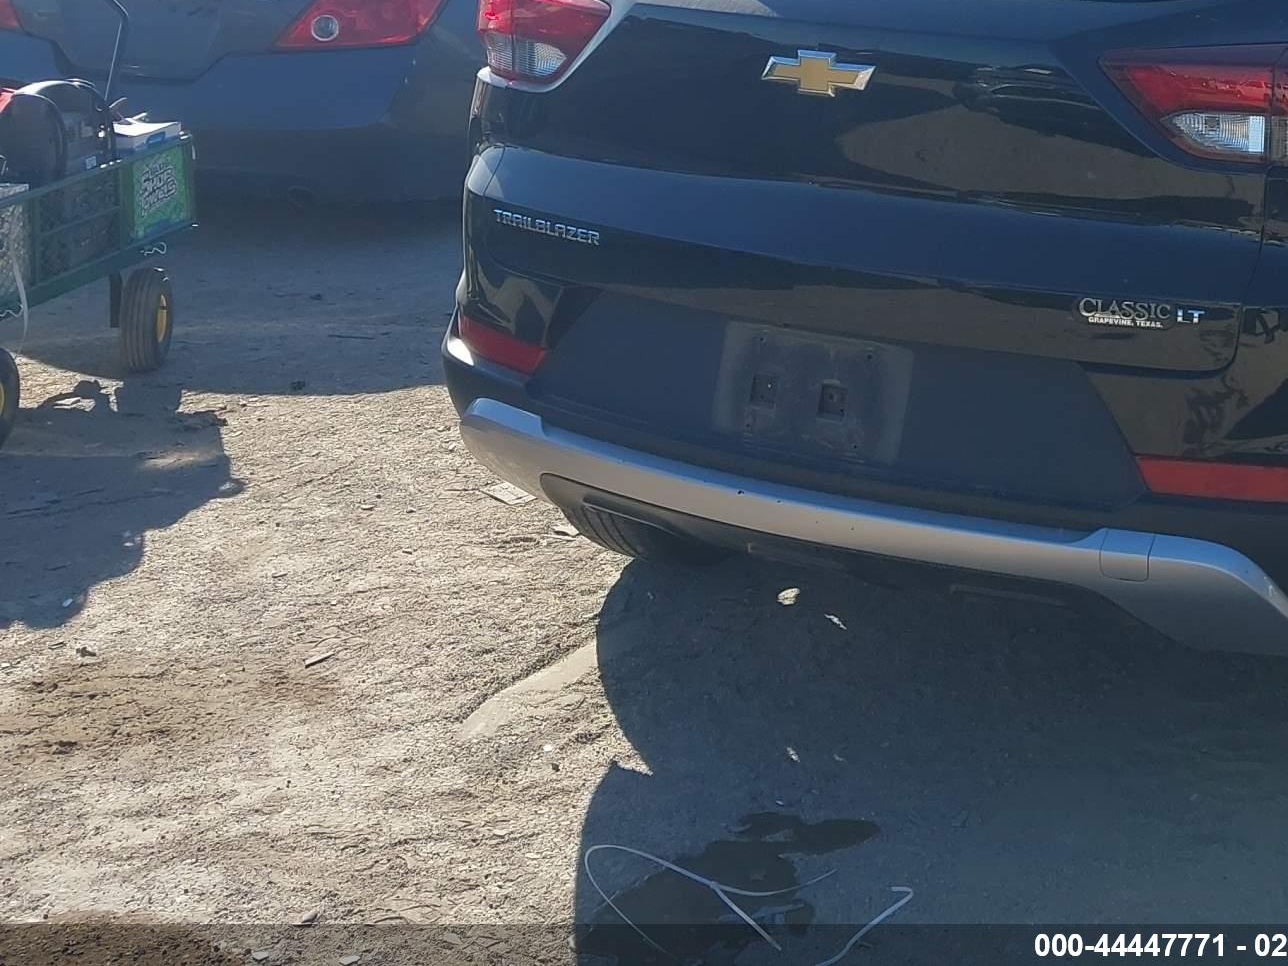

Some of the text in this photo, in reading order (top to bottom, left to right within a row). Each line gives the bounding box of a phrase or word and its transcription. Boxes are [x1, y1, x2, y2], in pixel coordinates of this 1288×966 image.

[494, 209, 600, 246] TRAILBLAZER
[1079, 297, 1171, 321] CLASSIC
[1177, 308, 1205, 323] LT
